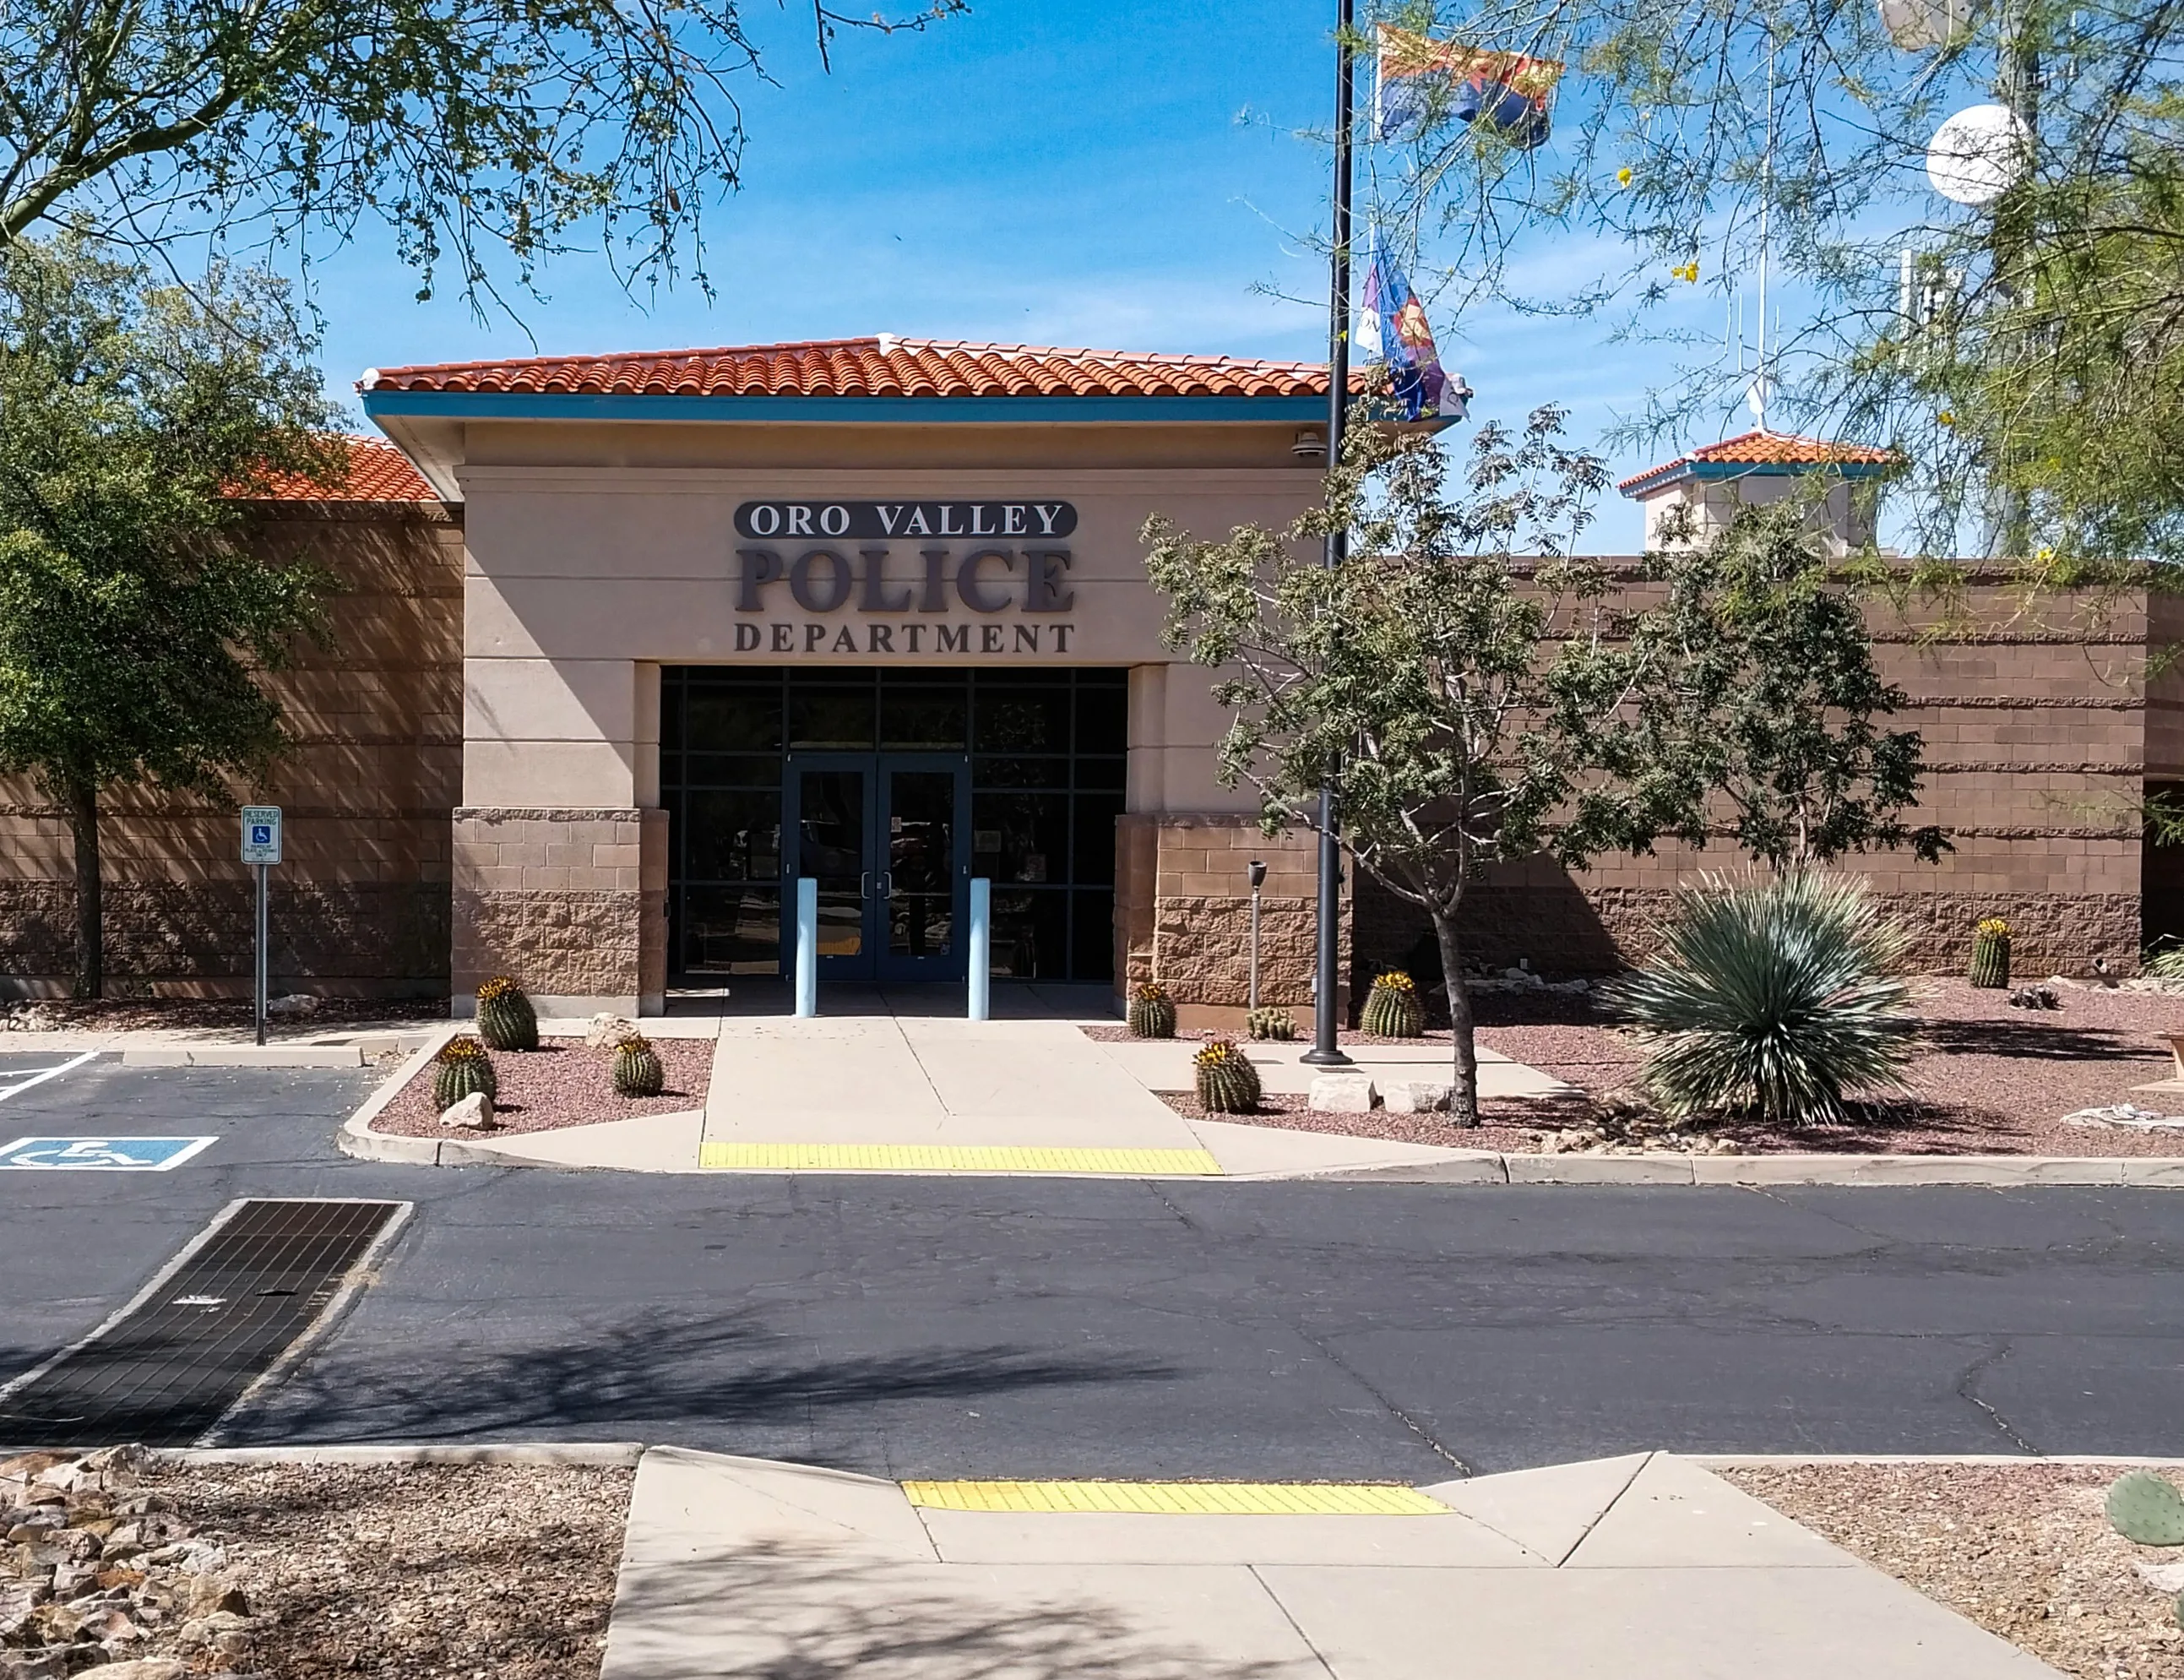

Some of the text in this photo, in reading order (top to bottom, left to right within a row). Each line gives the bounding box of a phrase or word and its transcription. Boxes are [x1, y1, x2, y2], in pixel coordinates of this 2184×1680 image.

[749, 503, 1063, 536] ORO VALLEY
[734, 548, 1075, 613] POLICE
[734, 623, 1075, 654] DEPARTMENT
